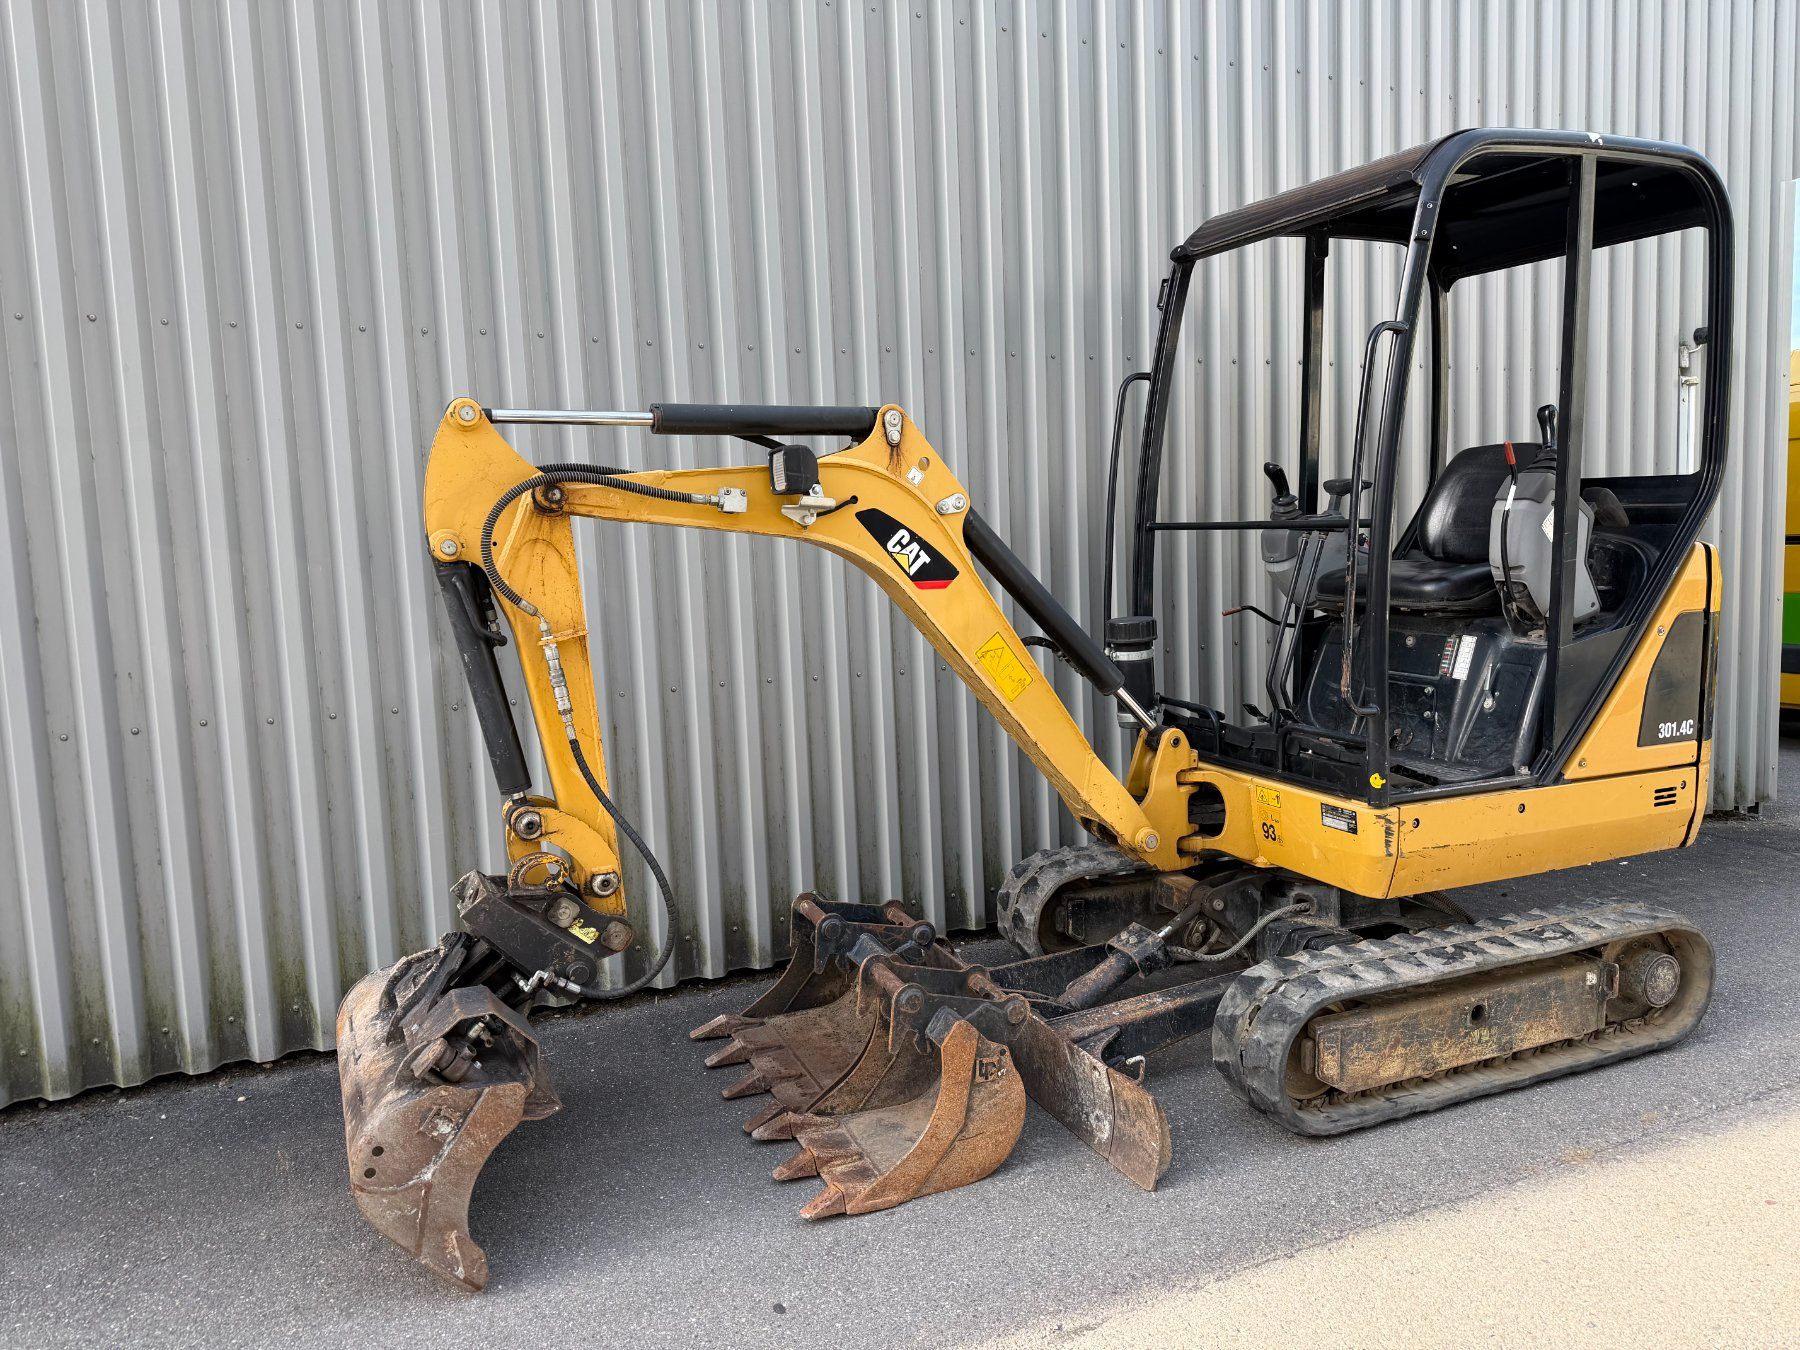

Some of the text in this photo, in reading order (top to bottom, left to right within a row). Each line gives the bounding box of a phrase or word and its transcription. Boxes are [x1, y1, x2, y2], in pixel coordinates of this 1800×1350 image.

[886, 528, 931, 576] CAT
[1658, 719, 1694, 739] 301.4C
[1262, 822, 1277, 841] 93
